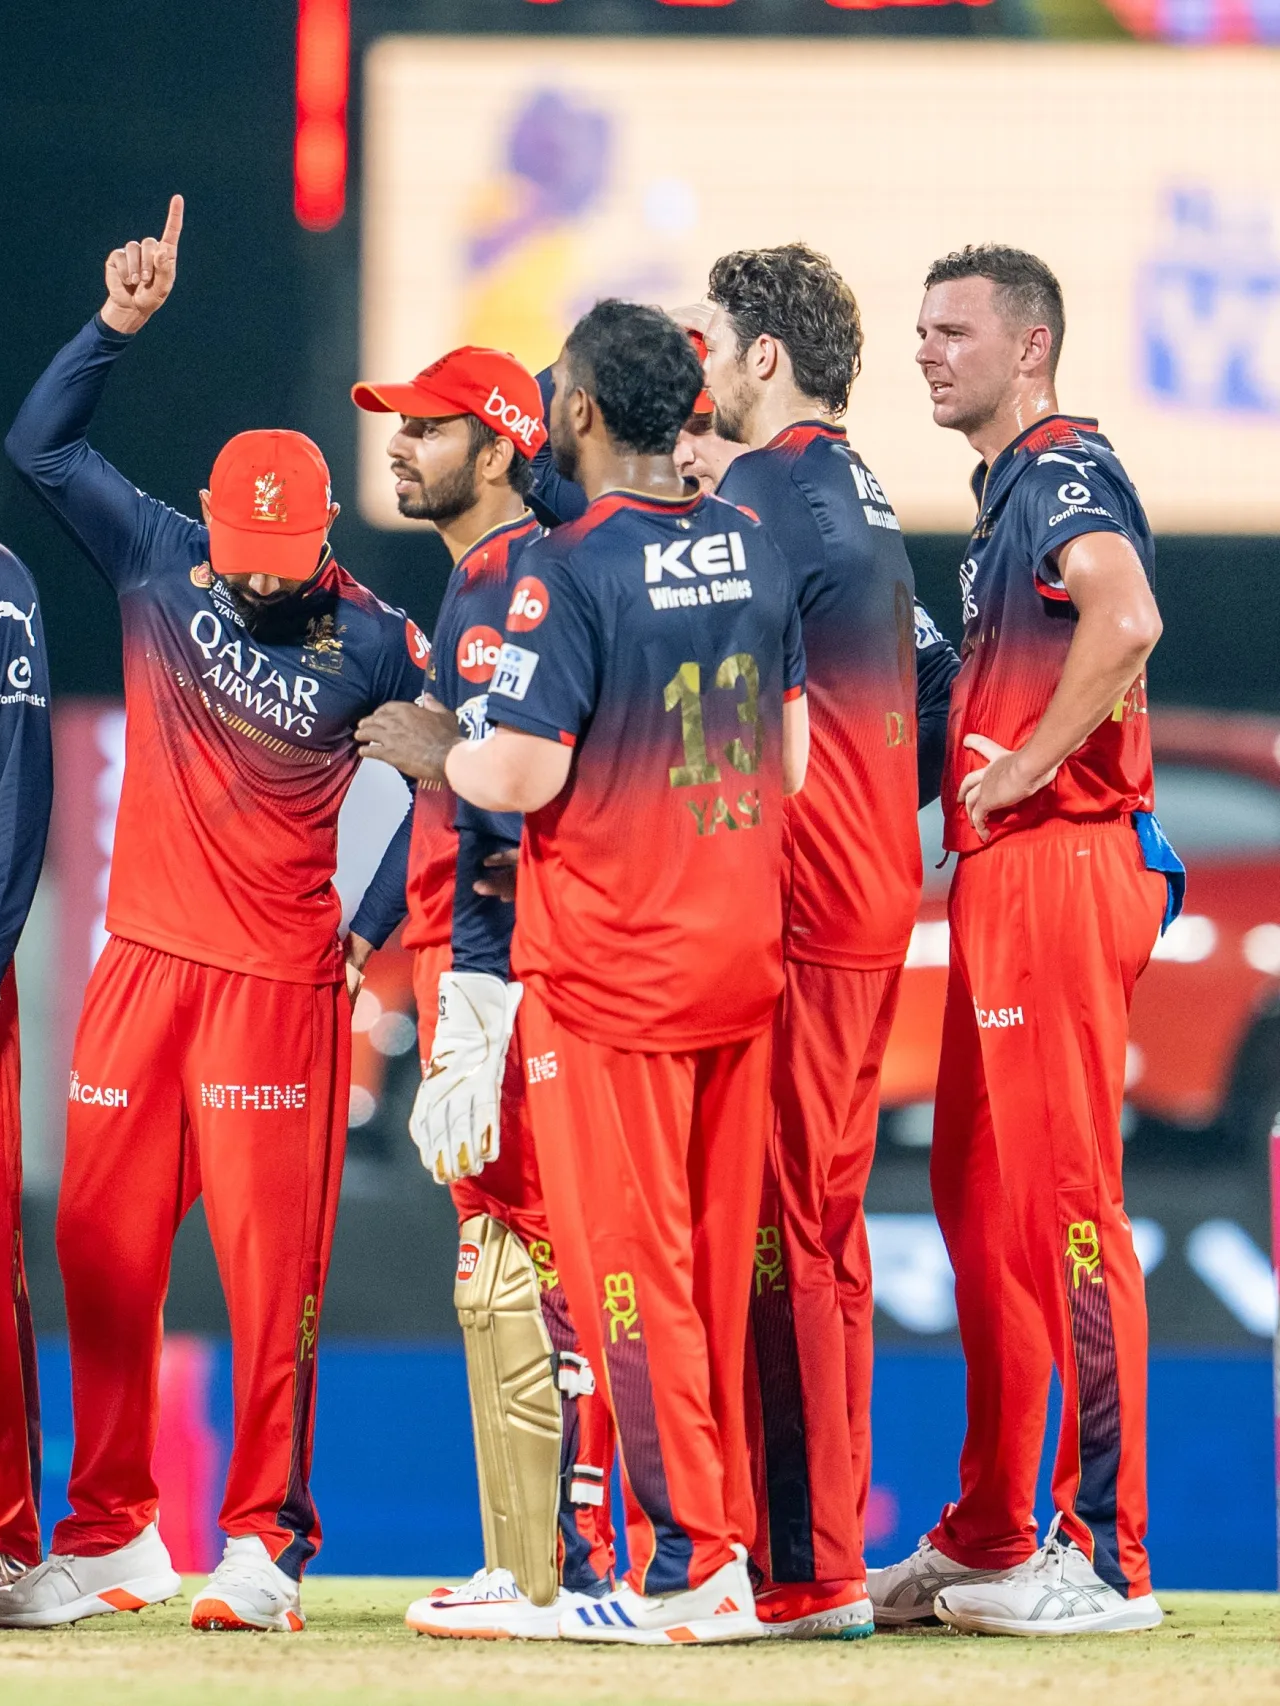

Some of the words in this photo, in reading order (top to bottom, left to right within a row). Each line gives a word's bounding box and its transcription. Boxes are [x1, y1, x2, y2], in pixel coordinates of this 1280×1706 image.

[849, 464, 887, 505] KE
[644, 531, 746, 583] KEI
[648, 586, 698, 611] Wires
[697, 585, 711, 605] &
[413, 630, 432, 659] Ji
[460, 639, 501, 668] Jio
[190, 610, 320, 715] QATAR
[496, 671, 521, 695] PL
[202, 664, 316, 738] AIRWAYS
[201, 1082, 306, 1110] NOTHING
[457, 1251, 478, 1273] SS
[1065, 1220, 1103, 1290] RCB
[602, 1271, 641, 1344] RCB
